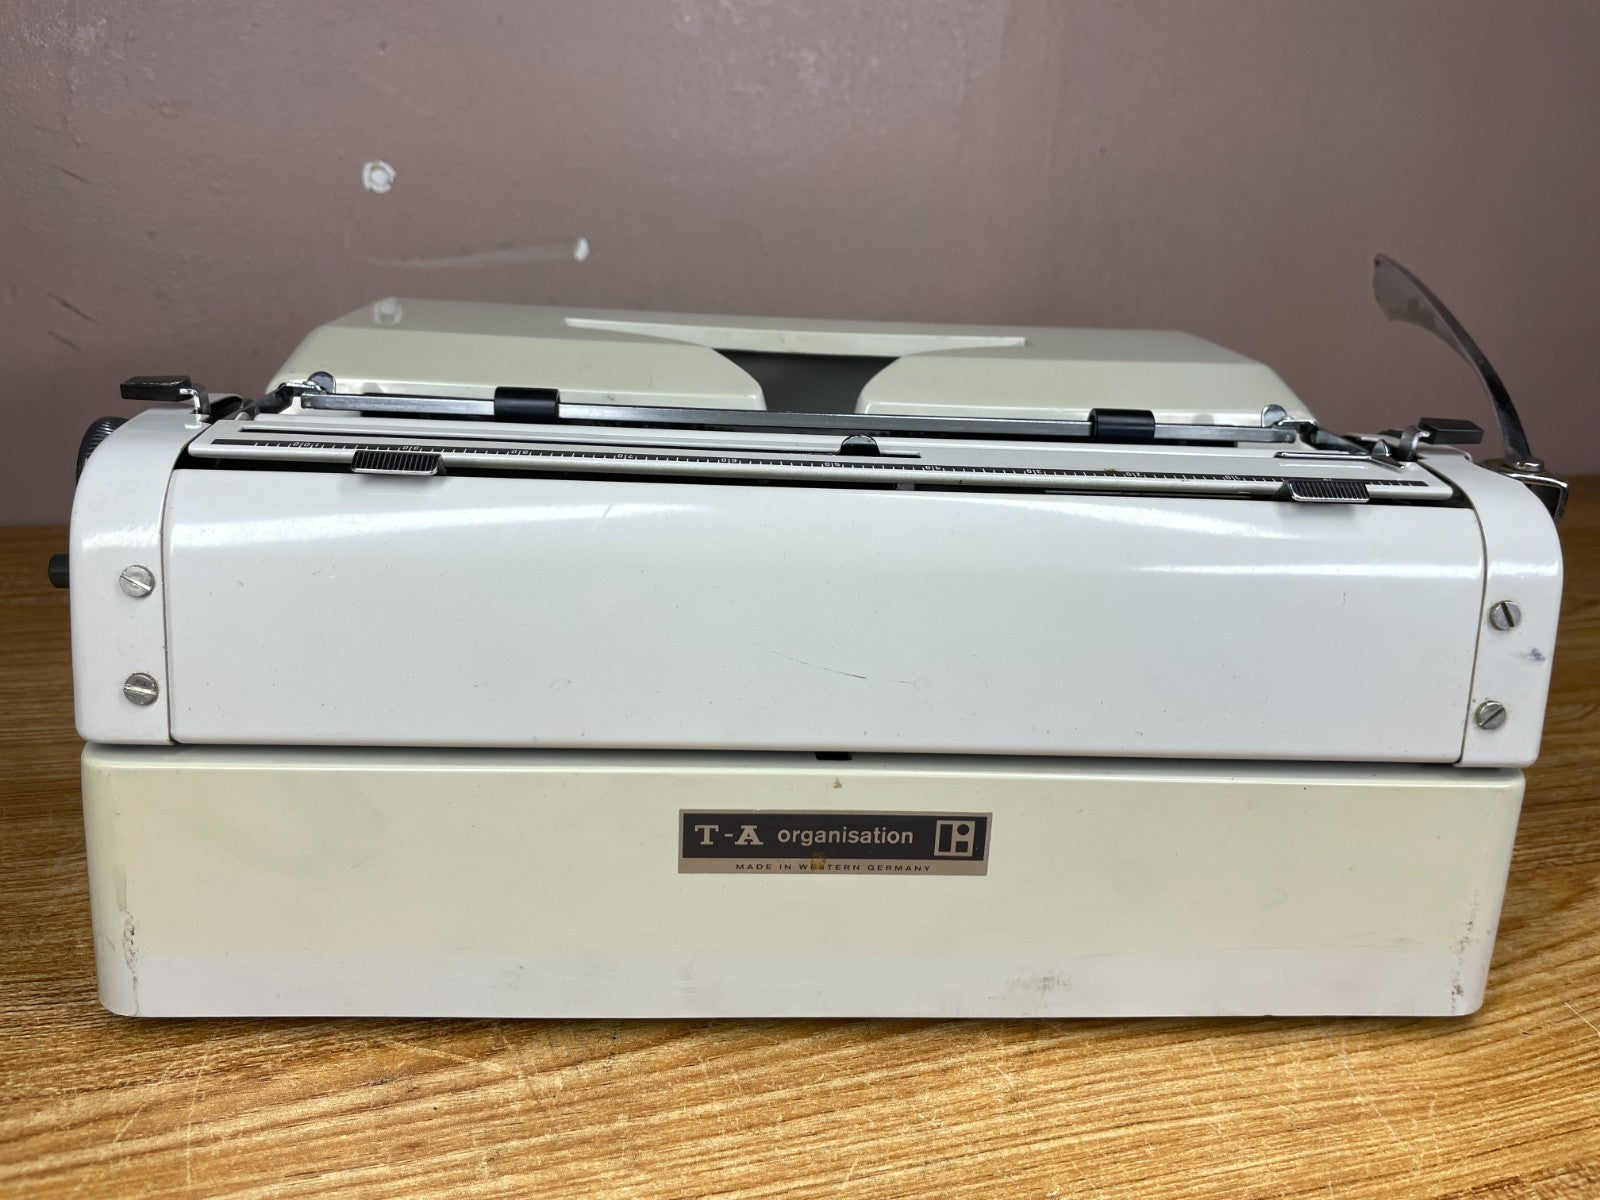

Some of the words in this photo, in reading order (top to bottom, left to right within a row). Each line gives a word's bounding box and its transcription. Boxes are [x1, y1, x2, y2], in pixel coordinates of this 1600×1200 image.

[777, 826, 914, 847] organisation
[799, 863, 860, 871] WESTERN
[867, 864, 931, 872] GERMANY
